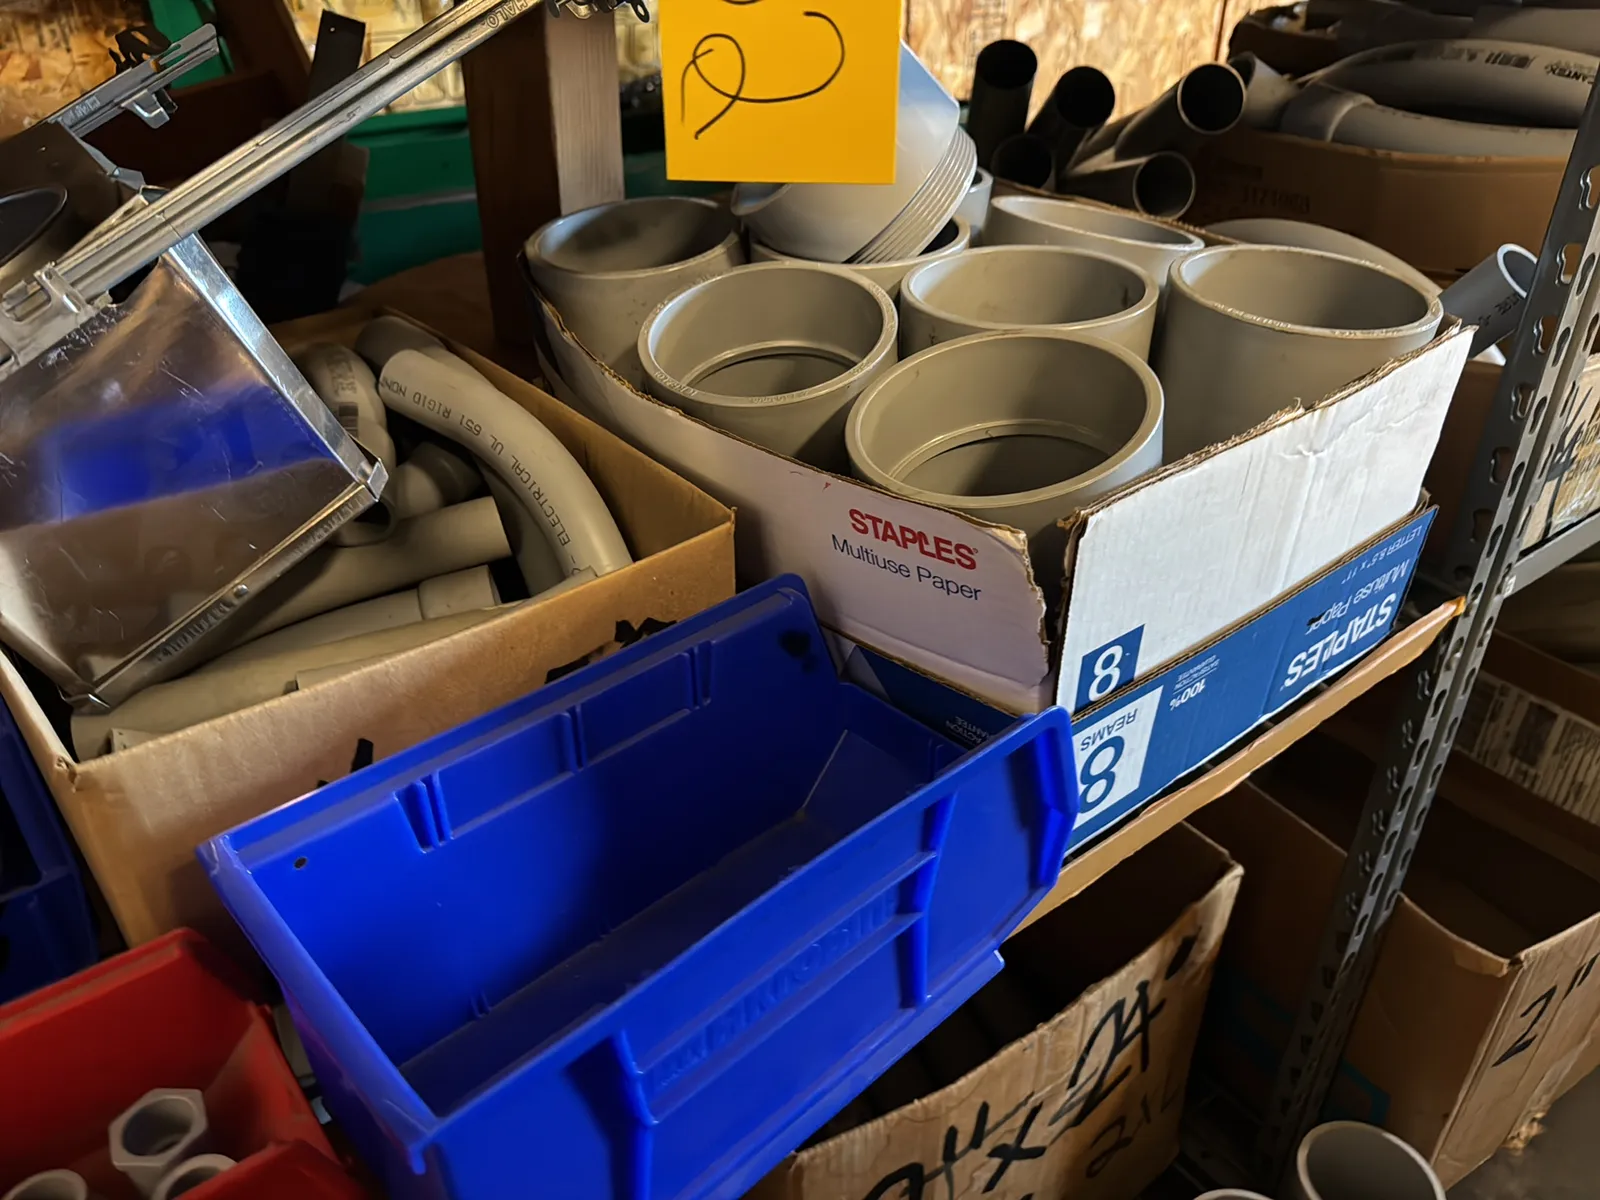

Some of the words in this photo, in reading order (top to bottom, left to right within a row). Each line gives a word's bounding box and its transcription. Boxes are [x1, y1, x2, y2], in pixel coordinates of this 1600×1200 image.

[412, 391, 452, 419] RIGID
[460, 414, 482, 436] 651
[490, 434, 505, 456] UL
[511, 454, 572, 547] ELECTRICAL
[1386, 525, 1423, 556] LETTER
[831, 534, 911, 579] Multiuse
[916, 566, 982, 600] Paper
[1353, 559, 1410, 605] Multiuse
[1284, 593, 1397, 687] STAPLES
[1088, 645, 1123, 702] 8
[1169, 679, 1207, 711] 100%
[1080, 707, 1139, 751] REAMS
[1079, 735, 1125, 814] 8
